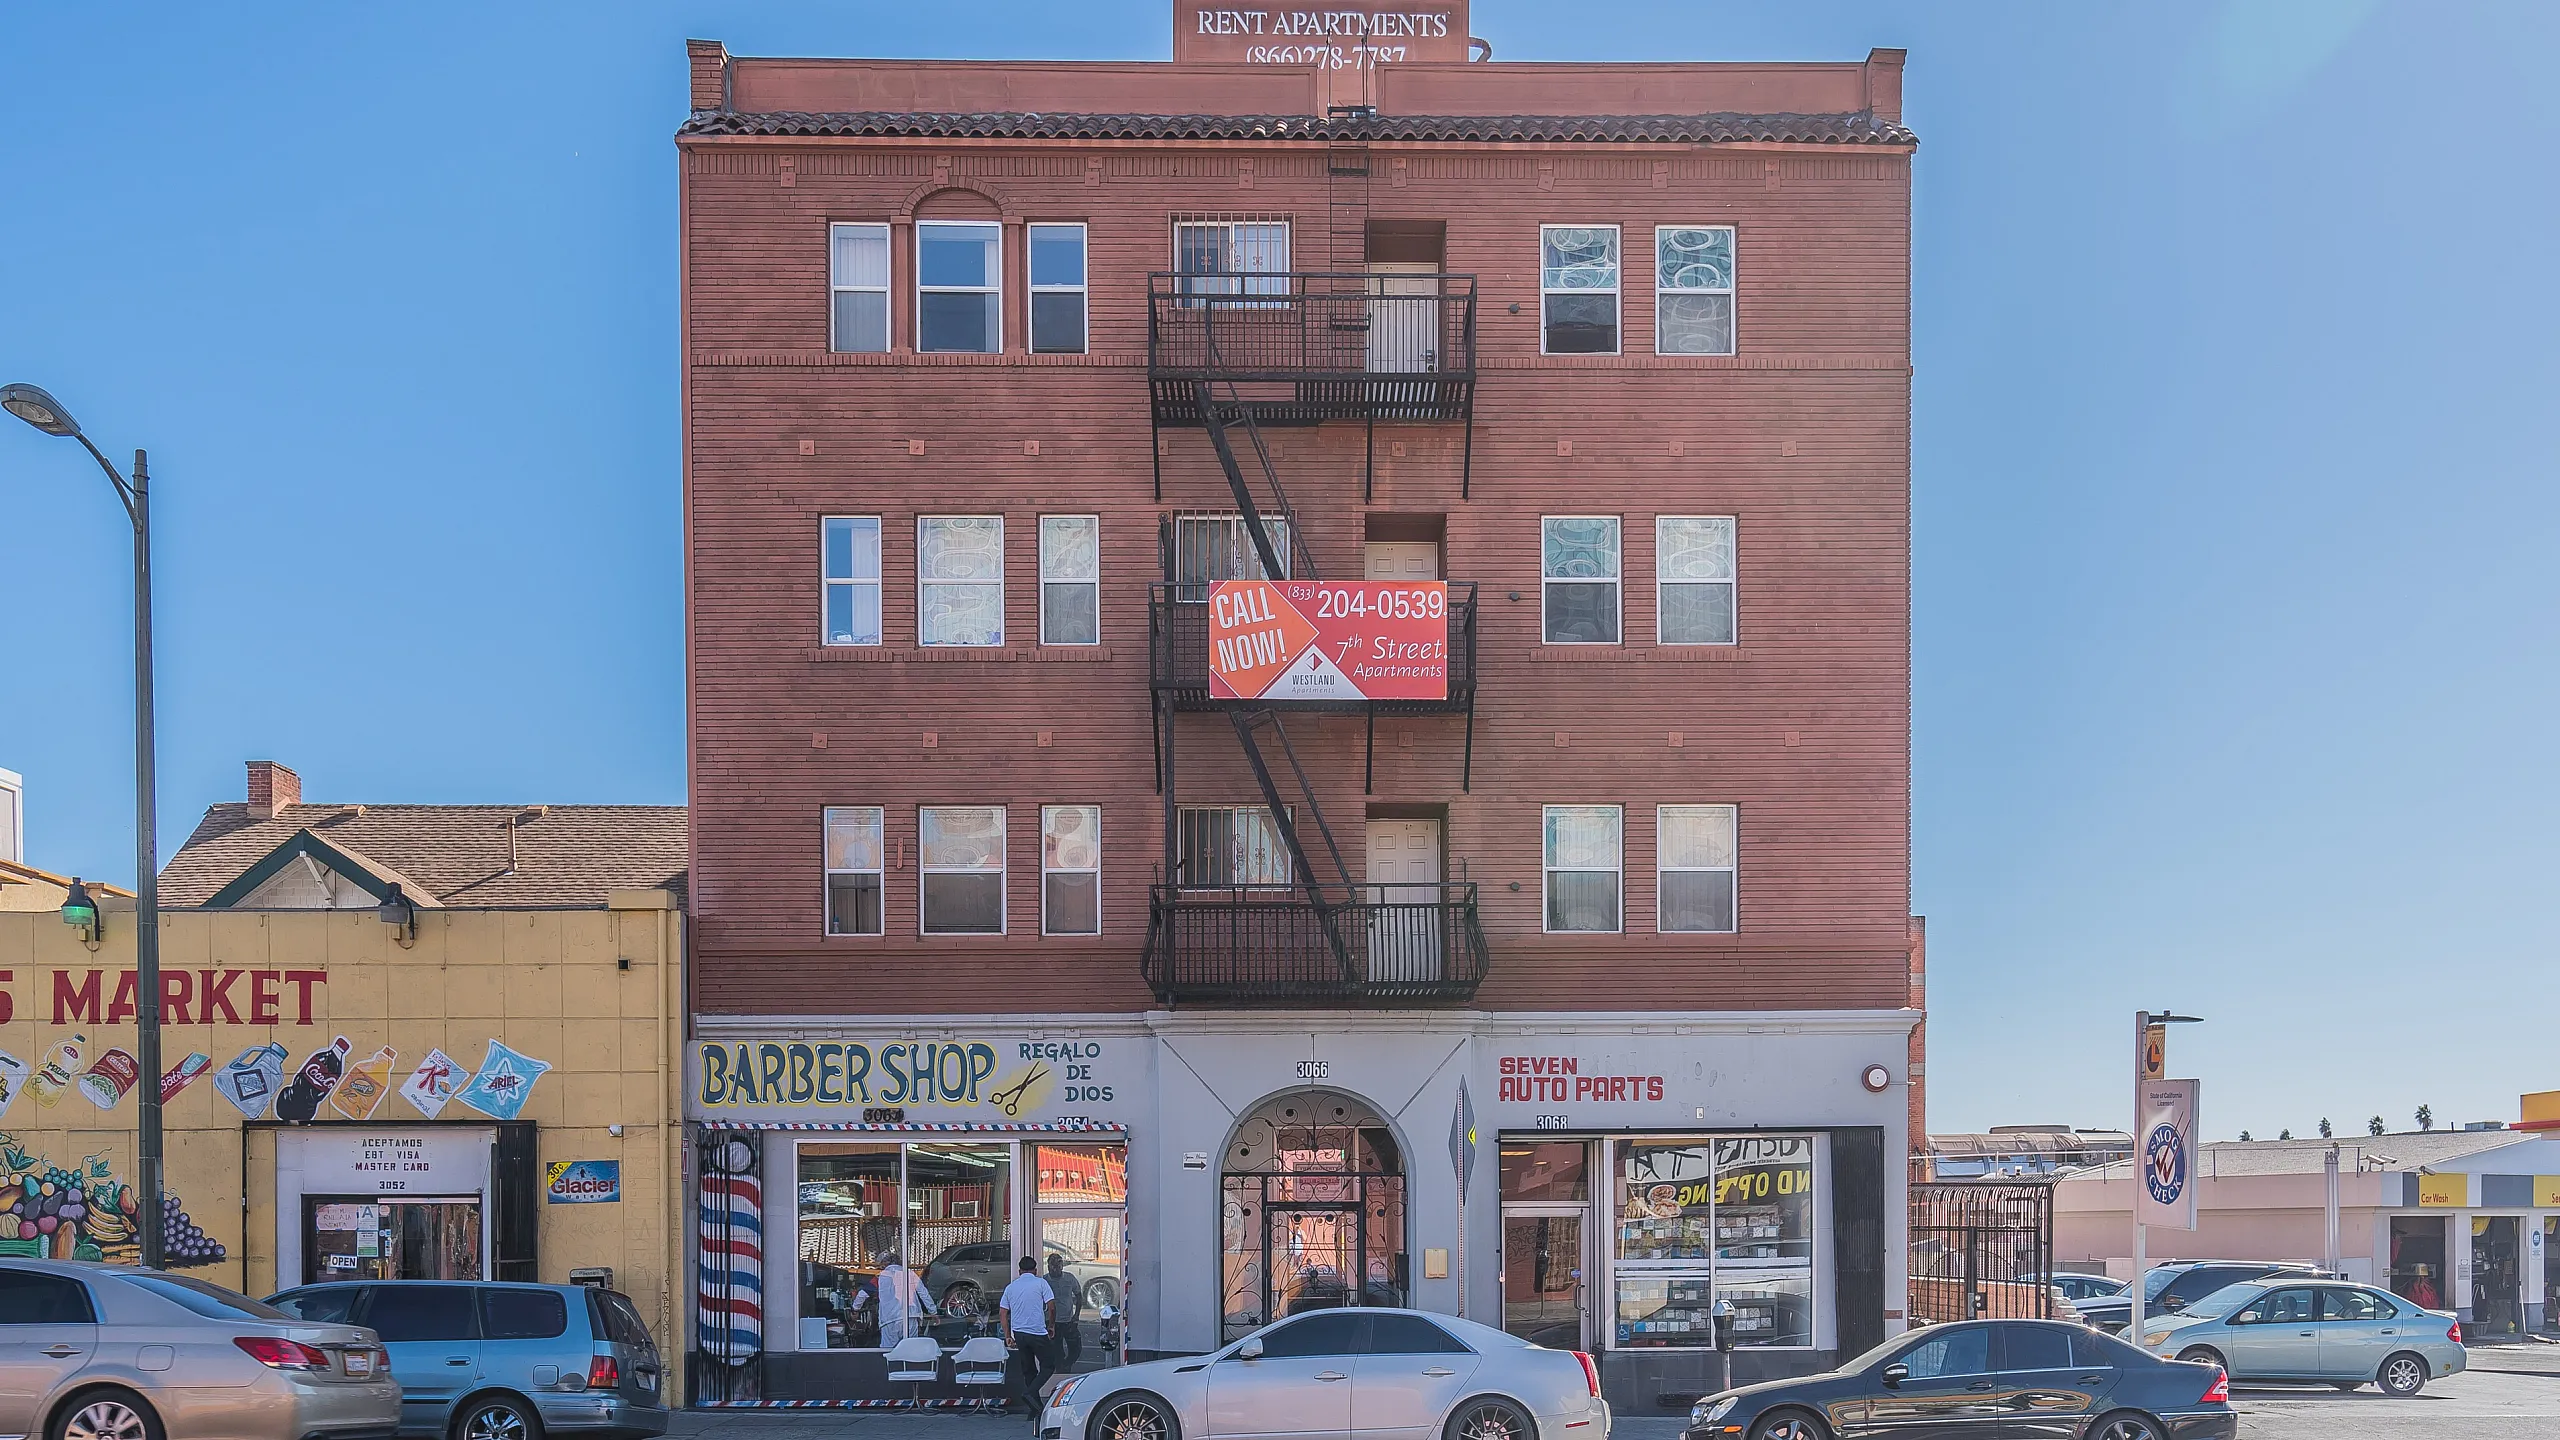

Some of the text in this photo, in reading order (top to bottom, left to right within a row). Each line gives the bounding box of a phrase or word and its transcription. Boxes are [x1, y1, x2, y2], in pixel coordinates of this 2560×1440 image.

[1197, 11, 1448, 38] RENT APARTMENTS
[1215, 586, 1276, 629] CALL
[1287, 584, 1443, 618] (833) 204-0539
[1217, 628, 1288, 674] NOW!
[1335, 634, 1442, 665] 7th Street
[1353, 661, 1442, 679] Apartments
[1292, 674, 1335, 686] WESTLAND
[1291, 686, 1335, 695] Apartments
[51, 970, 328, 1026] MARKET
[1019, 1042, 1101, 1060] REGALO
[701, 1043, 996, 1104] BARBER SHOP
[1066, 1064, 1091, 1080] DE
[1297, 1062, 1328, 1078] 3066
[1499, 1056, 1577, 1075] SEVEN
[1065, 1086, 1114, 1102] DIOS
[1499, 1076, 1663, 1101] AUTO PARTS
[1537, 1116, 1567, 1129] 3068
[362, 1138, 422, 1147] ACEPTAMOS
[2151, 1129, 2179, 1152] SMOG
[365, 1150, 420, 1159] EBT VISA
[355, 1162, 430, 1171] MASTER CARD
[379, 1181, 406, 1189] 3052
[551, 1177, 616, 1194] Glacier
[2149, 1175, 2182, 1202] CHECK
[2421, 1193, 2449, 1204] Car Wash
[361, 1206, 374, 1219] A
[331, 1256, 356, 1267] OPEN
